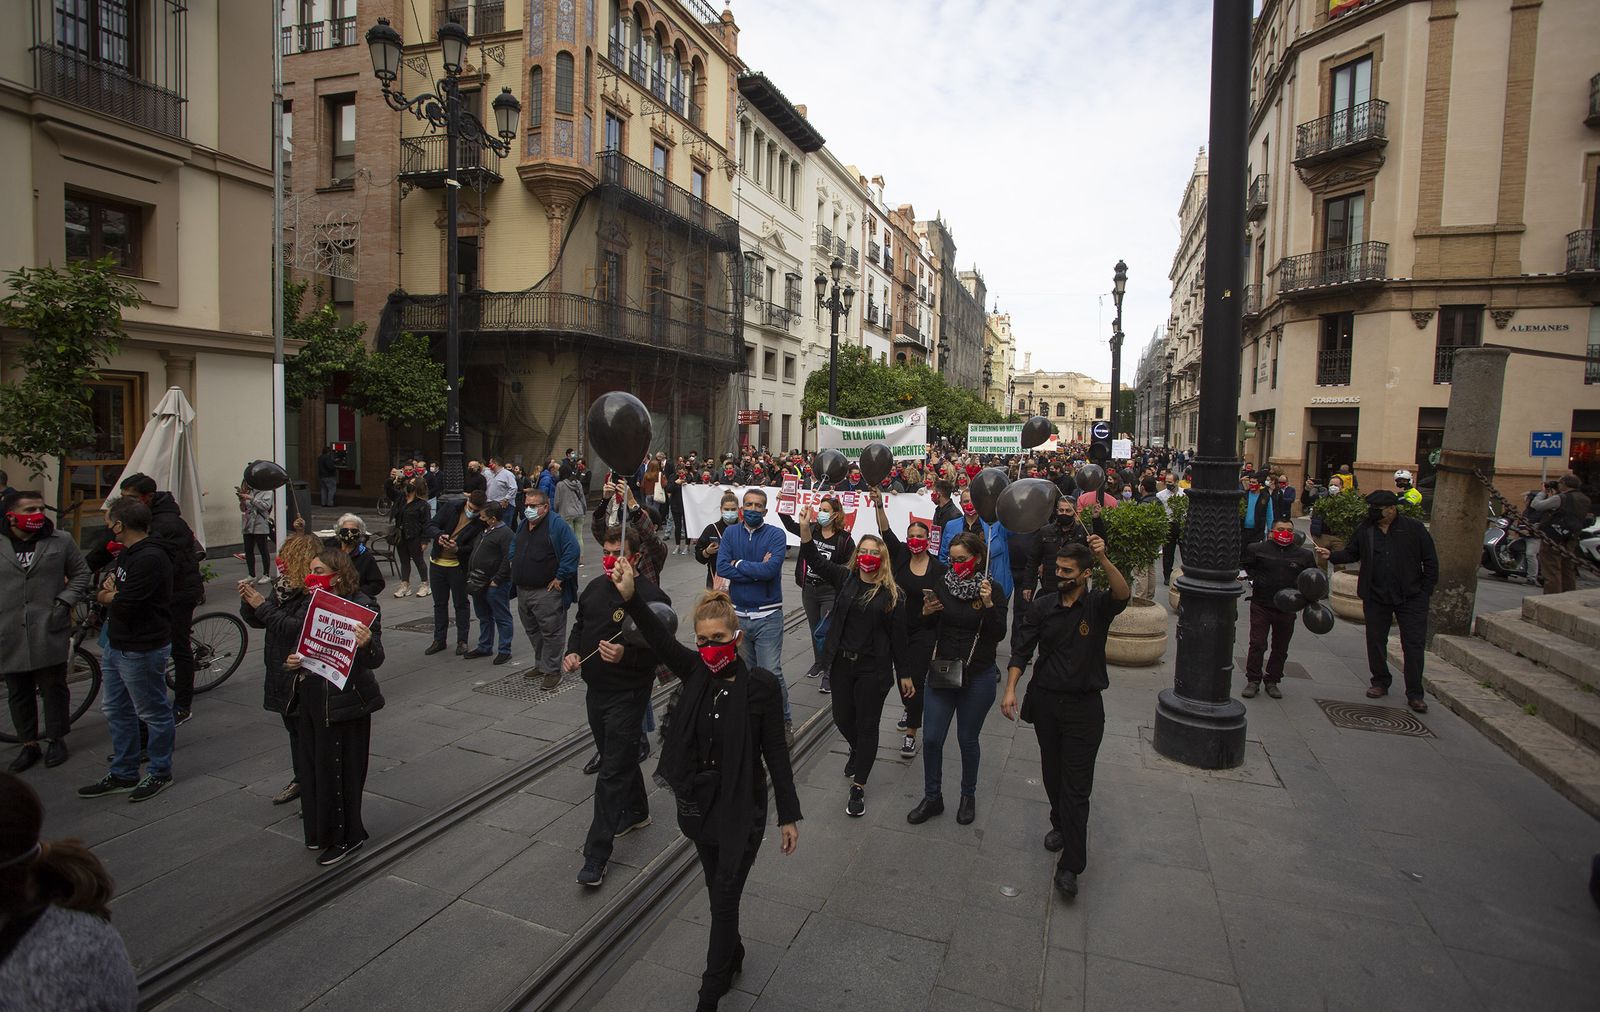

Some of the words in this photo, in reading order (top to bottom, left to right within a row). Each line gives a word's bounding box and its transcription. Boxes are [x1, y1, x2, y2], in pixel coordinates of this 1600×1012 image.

[1510, 324, 1569, 332] ALEMANES
[1310, 396, 1360, 404] STARBUCKS
[867, 417, 877, 426] DE
[878, 414, 904, 426] FERIAS
[842, 430, 852, 440] EN
[853, 431, 862, 440] LA
[863, 429, 886, 440] RUINA
[1533, 440, 1562, 449] TAXI
[893, 445, 926, 457] URGENTES
[796, 493, 859, 507] RESAE
[864, 495, 889, 508] Y!
[318, 614, 330, 625] SIN
[303, 637, 352, 667] MANIFESTACIÓN
